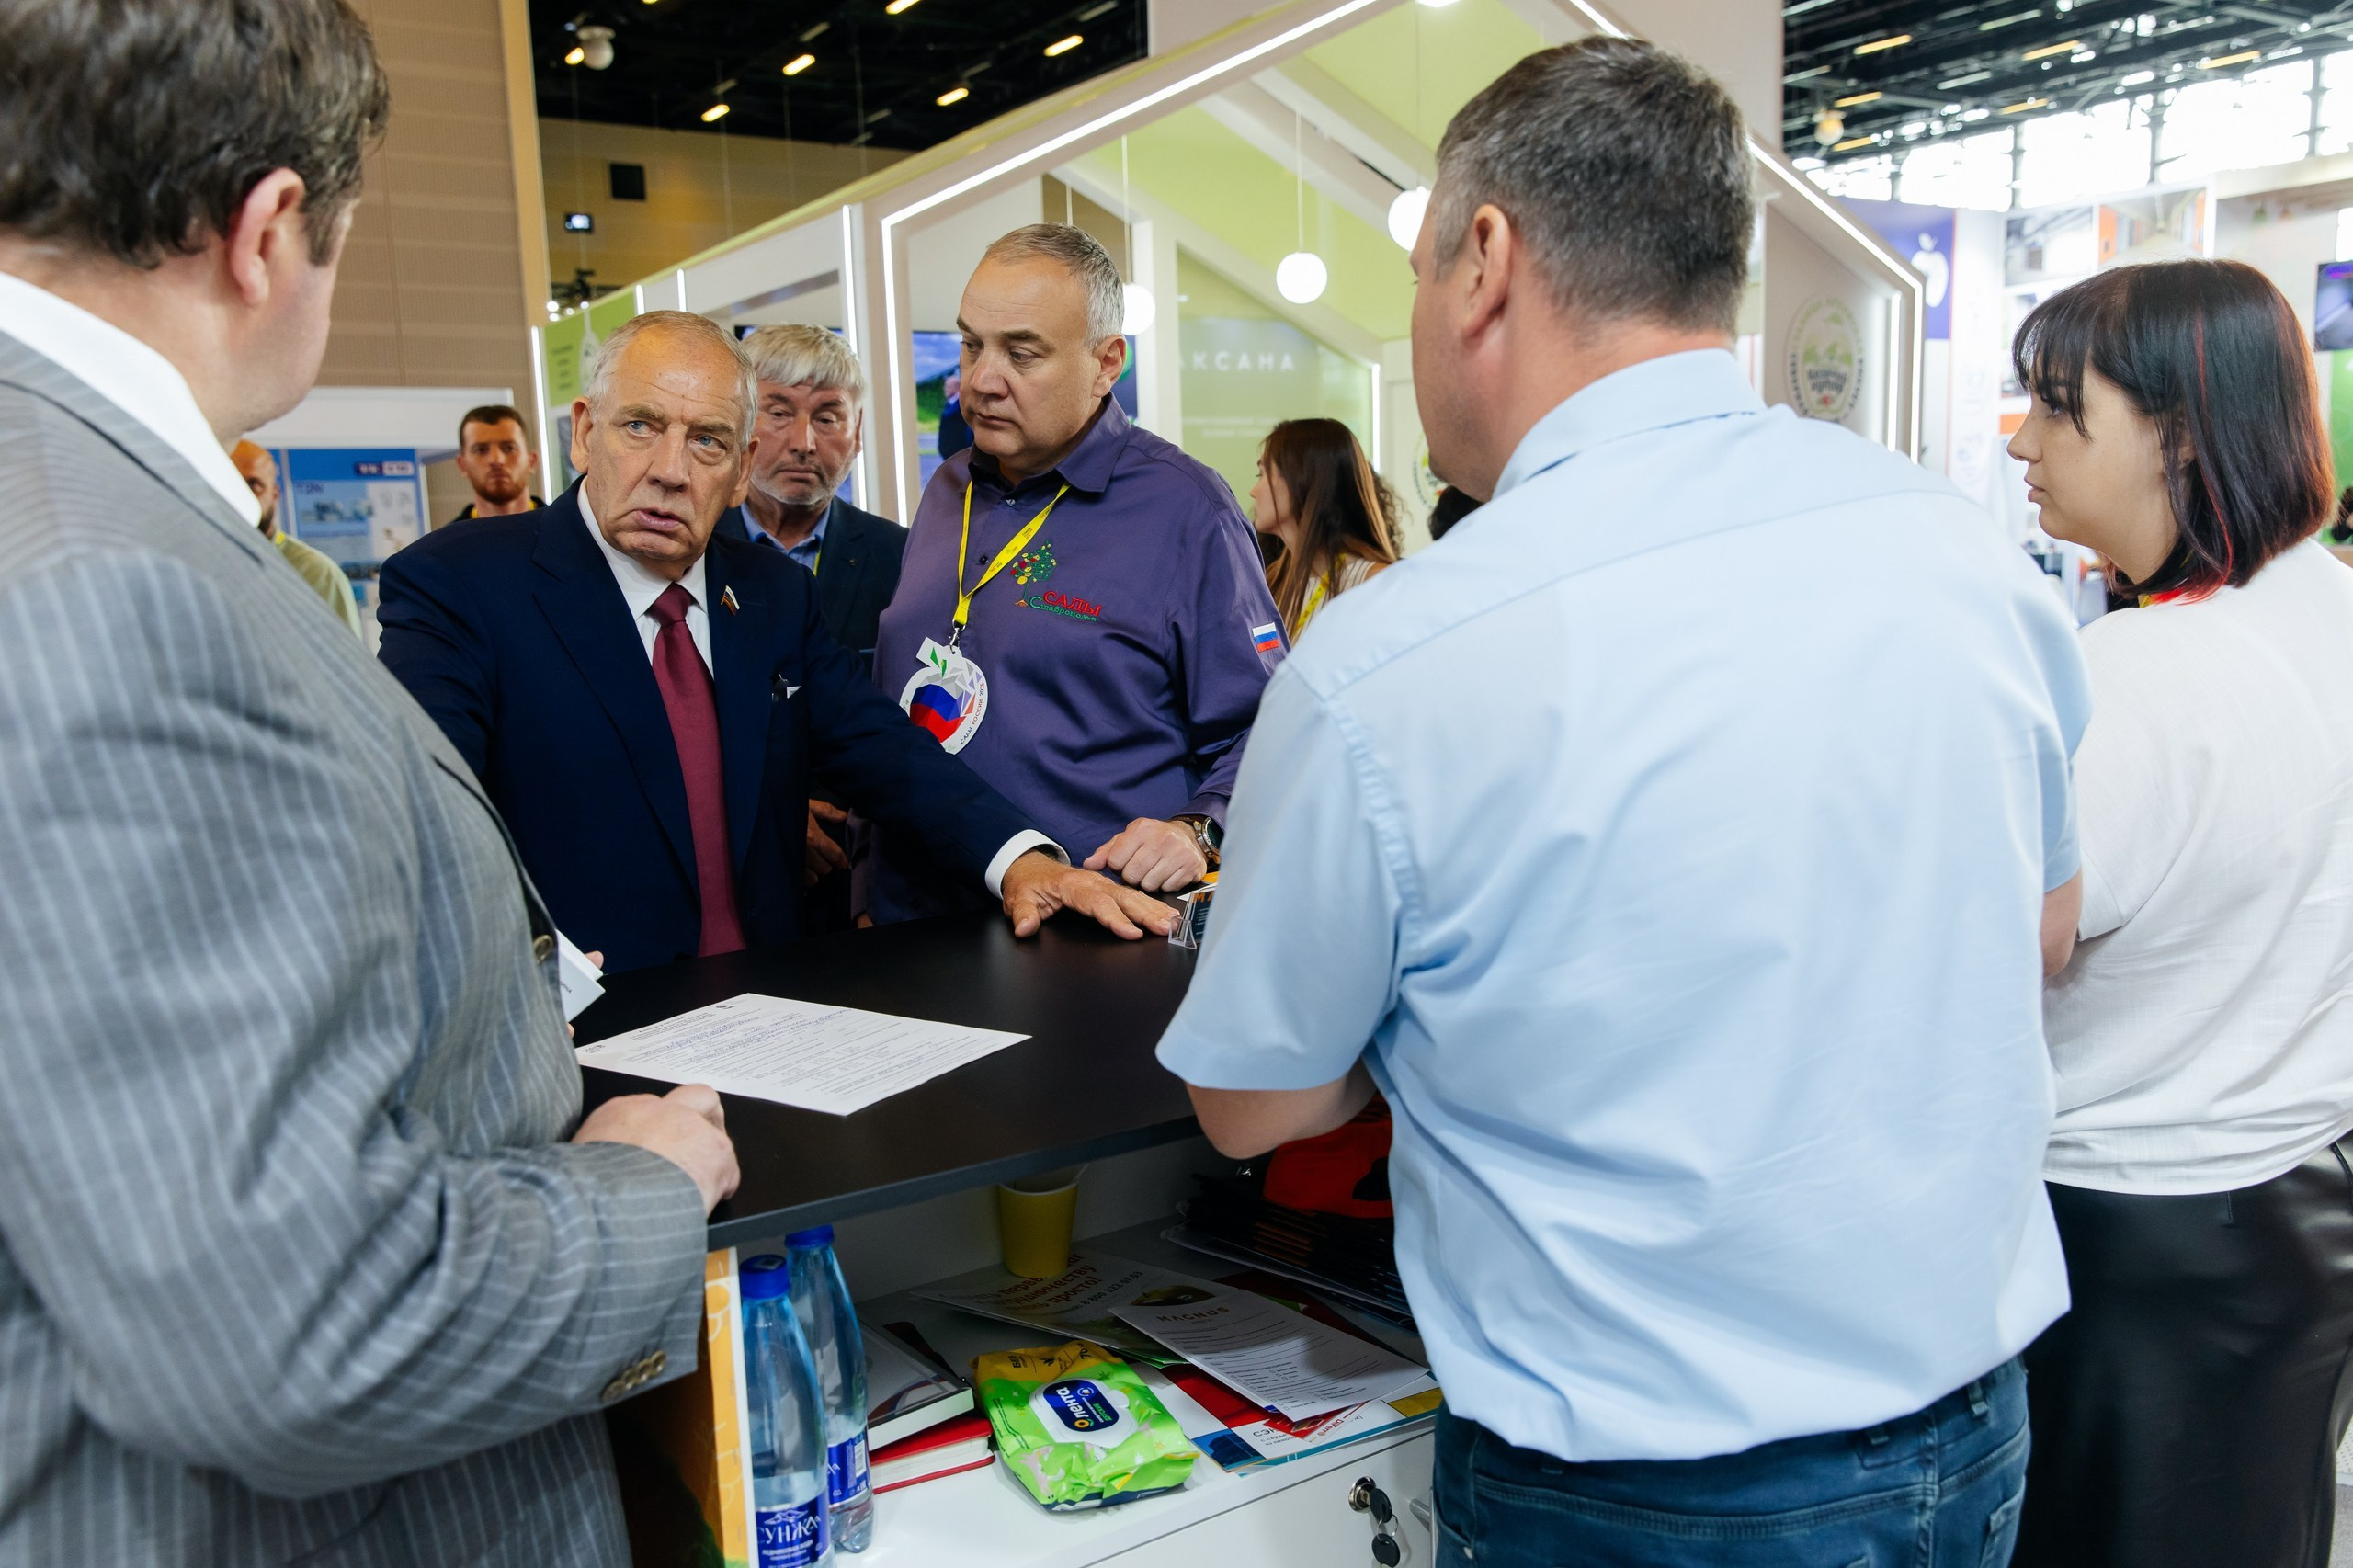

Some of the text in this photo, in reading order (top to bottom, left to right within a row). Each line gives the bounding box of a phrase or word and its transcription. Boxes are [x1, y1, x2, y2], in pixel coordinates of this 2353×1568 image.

[1180, 351, 1294, 371] КСАНА
[1029, 596, 1097, 622] Ставрополья
[1043, 591, 1102, 616] САДЫ
[960, 726, 972, 744] САДЫ
[972, 699, 983, 725] РОССИИ
[1047, 1276, 1103, 1302] просто!
[1156, 1307, 1229, 1322] MAGNUS
[1008, 1356, 1022, 1369] БЕЗ
[1056, 1386, 1089, 1419] лента
